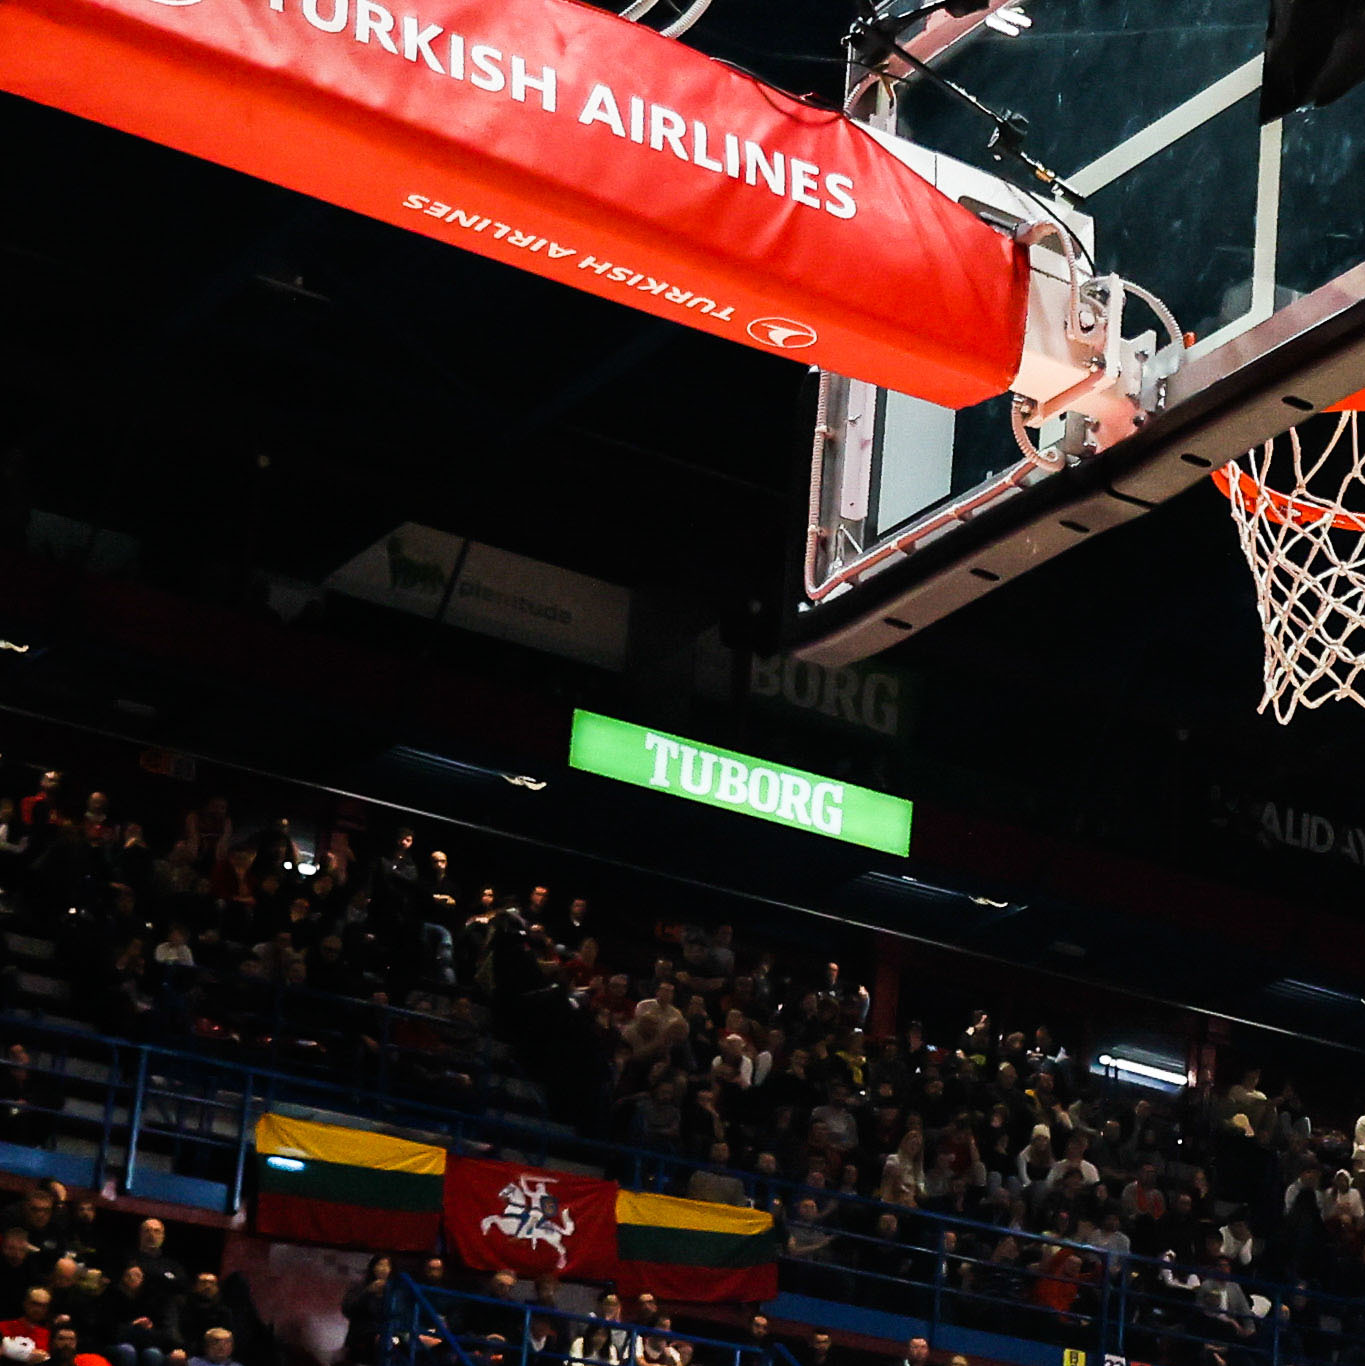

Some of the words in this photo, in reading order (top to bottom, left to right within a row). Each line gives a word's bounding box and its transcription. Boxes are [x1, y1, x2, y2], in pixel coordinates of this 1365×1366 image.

[270, 0, 557, 113] URKISH
[578, 83, 858, 221] AIRLINES
[402, 193, 580, 261] AIRLINES
[578, 253, 736, 323] TURKISH
[644, 732, 844, 836] TUBORG
